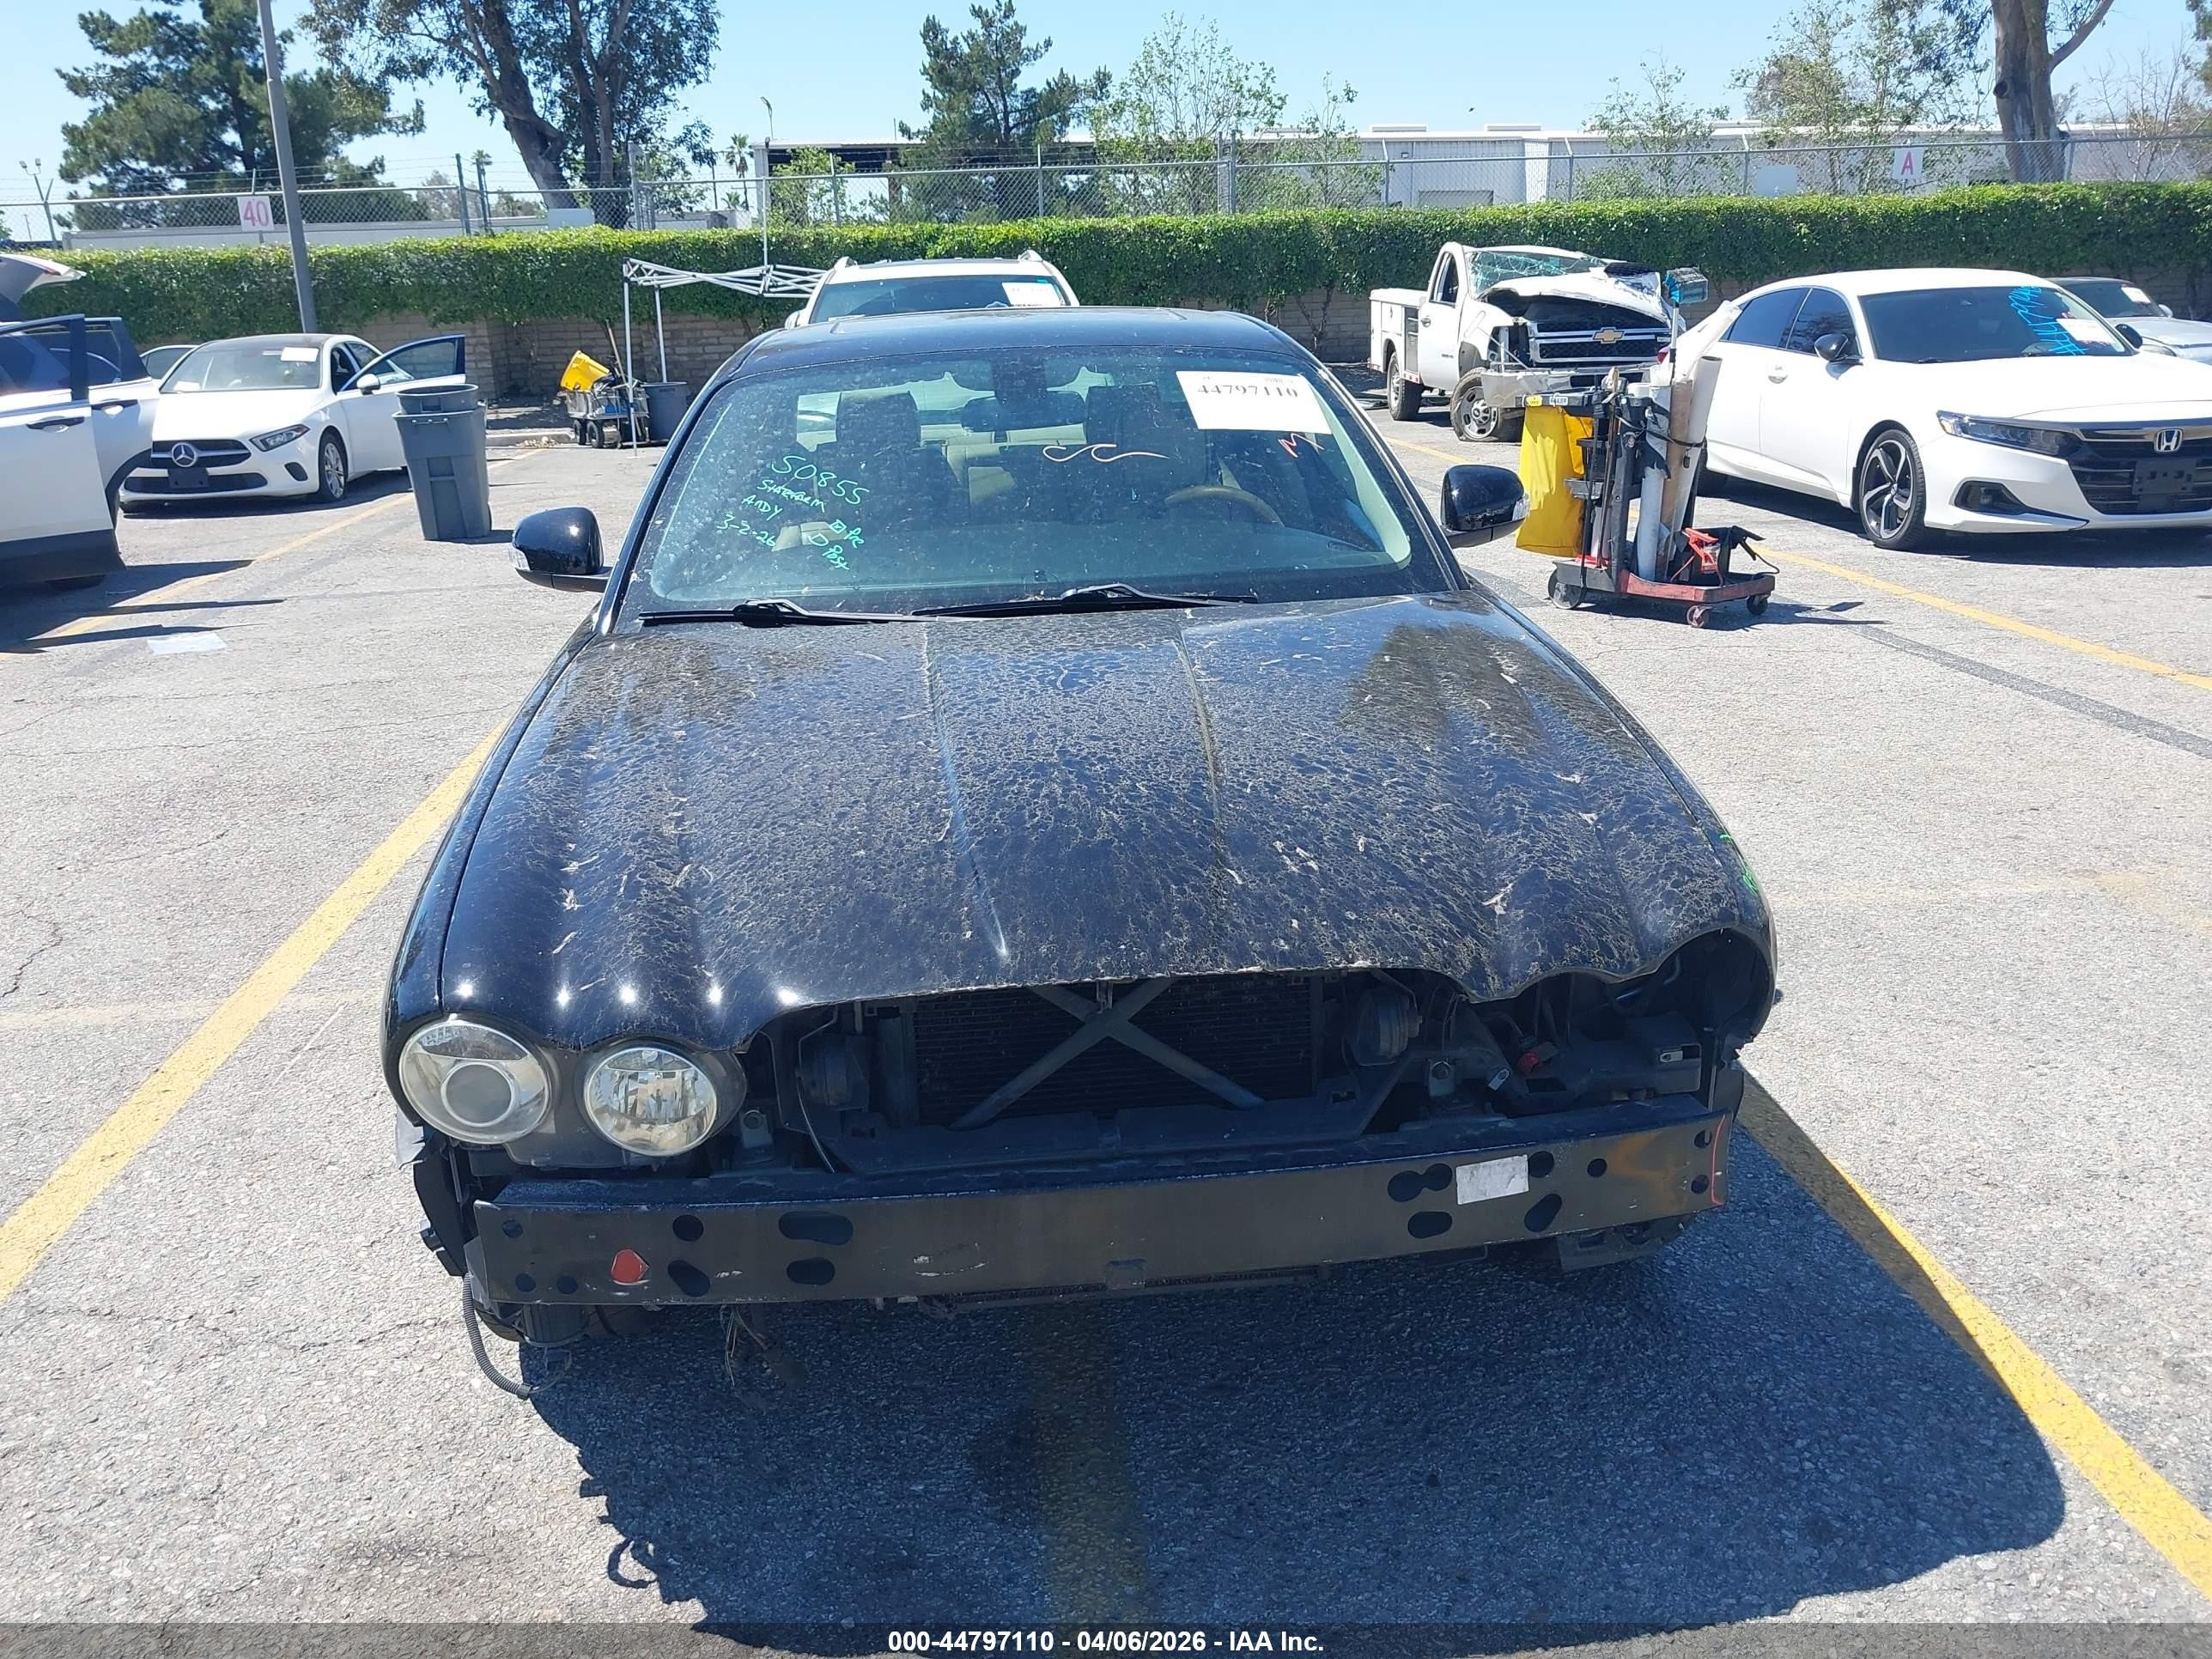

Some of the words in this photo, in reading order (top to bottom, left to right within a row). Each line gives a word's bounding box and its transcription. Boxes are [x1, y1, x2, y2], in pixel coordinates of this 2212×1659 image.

[1900, 150, 1914, 175] A
[243, 200, 270, 228] 40
[1197, 384, 1299, 398] 44797110
